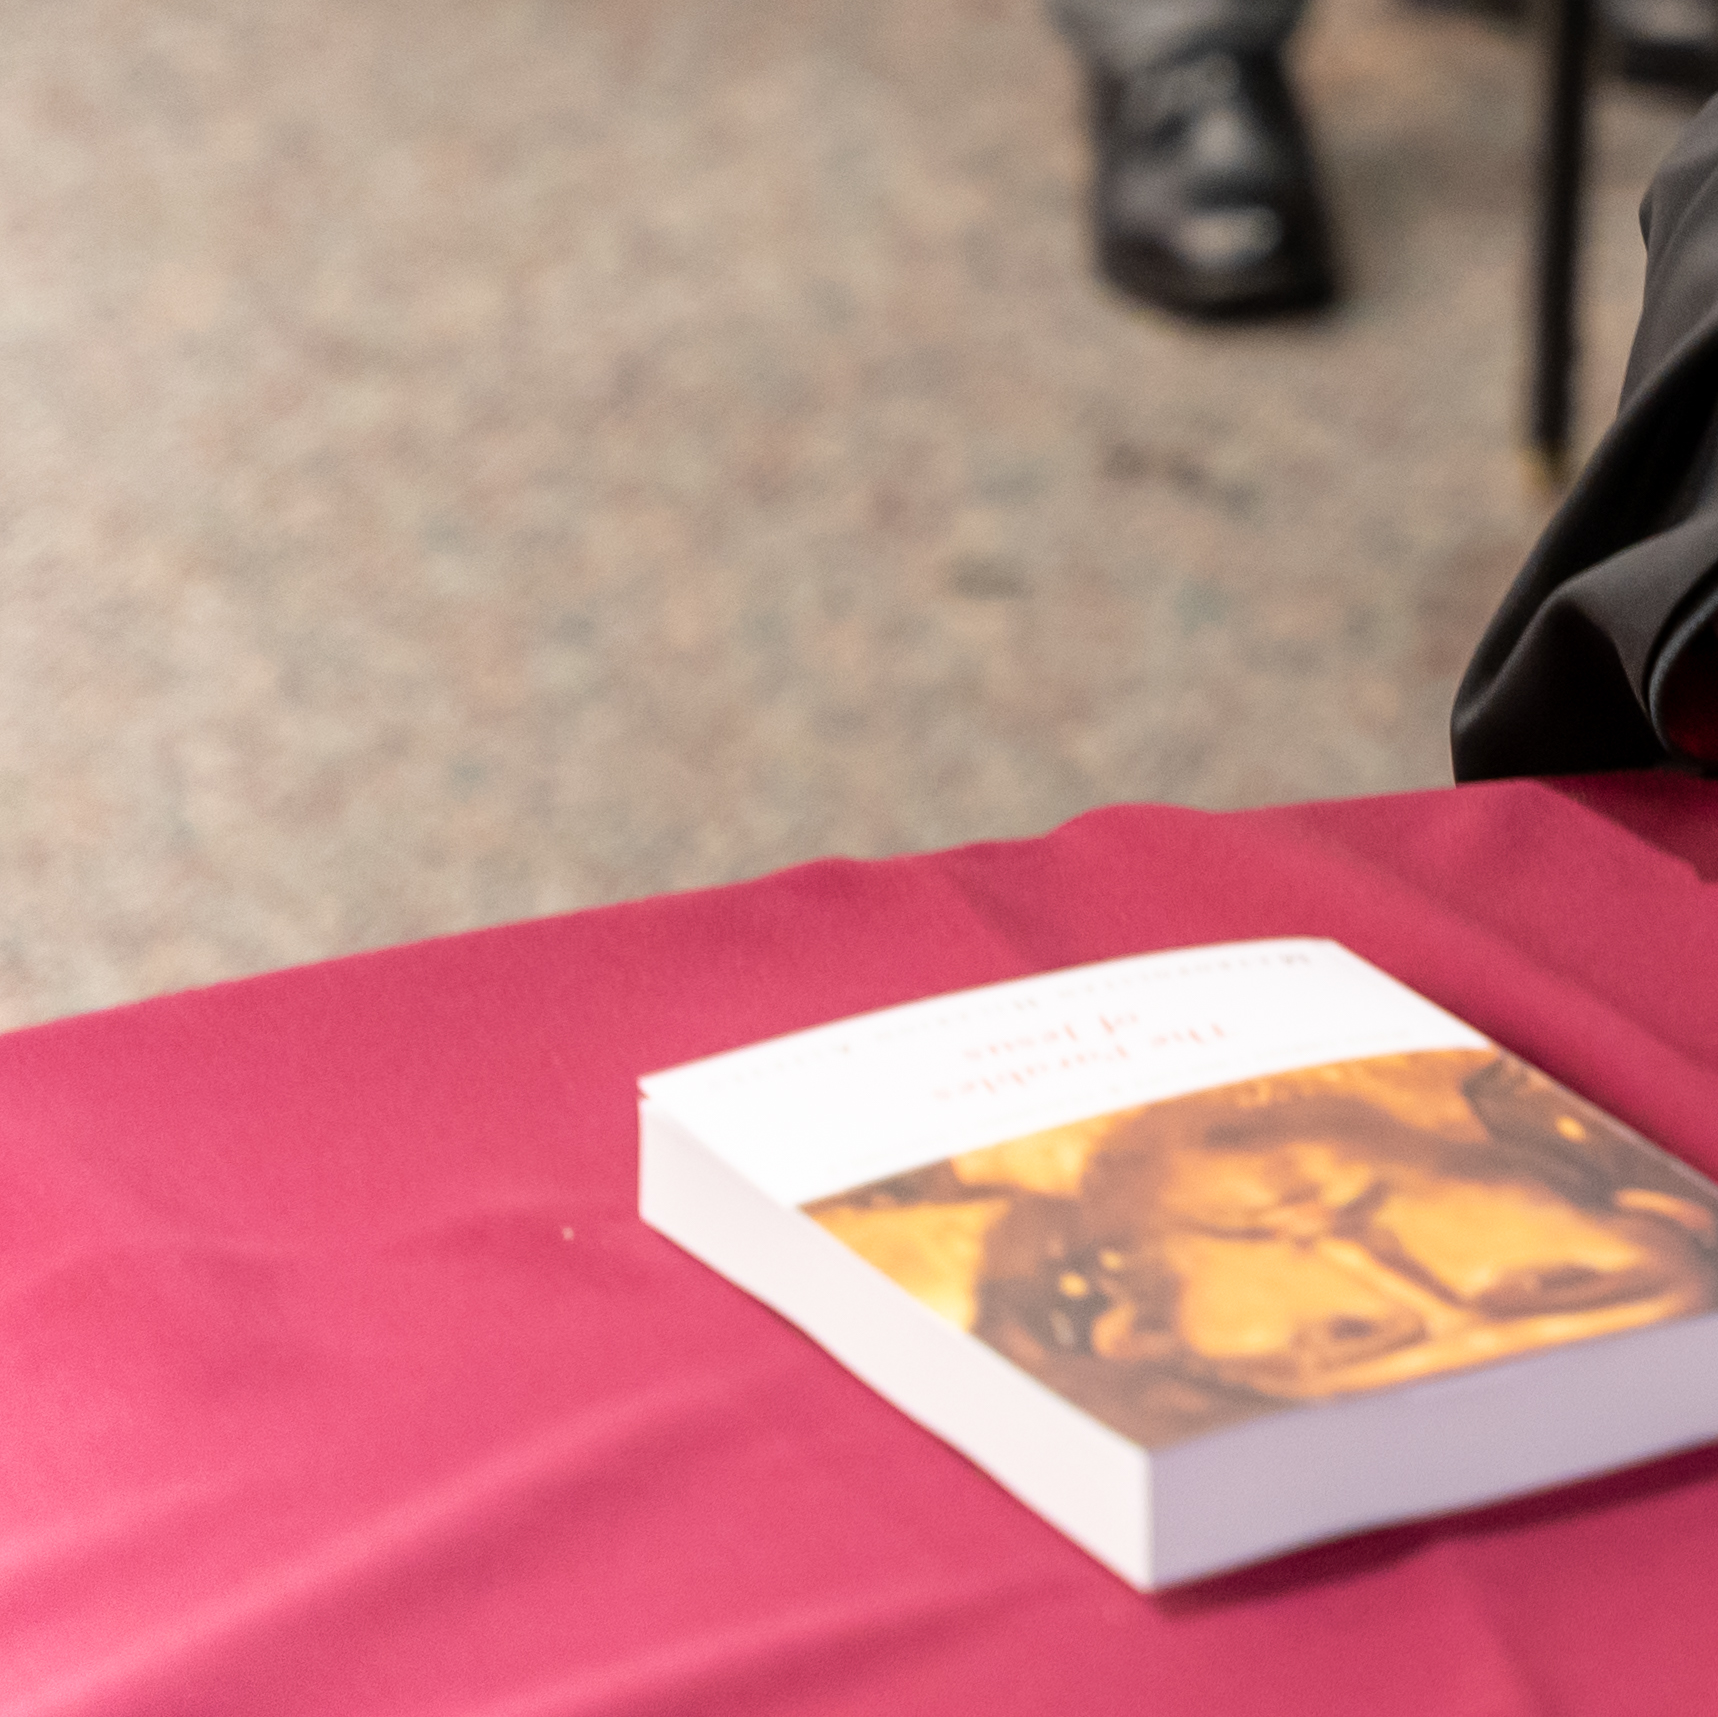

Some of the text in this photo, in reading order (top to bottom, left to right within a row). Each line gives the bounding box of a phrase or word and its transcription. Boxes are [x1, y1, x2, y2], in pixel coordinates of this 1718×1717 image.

[961, 1011, 1141, 1060] of Jesus
[1147, 1019, 1232, 1053] The
[930, 1042, 1132, 1102] Parables
